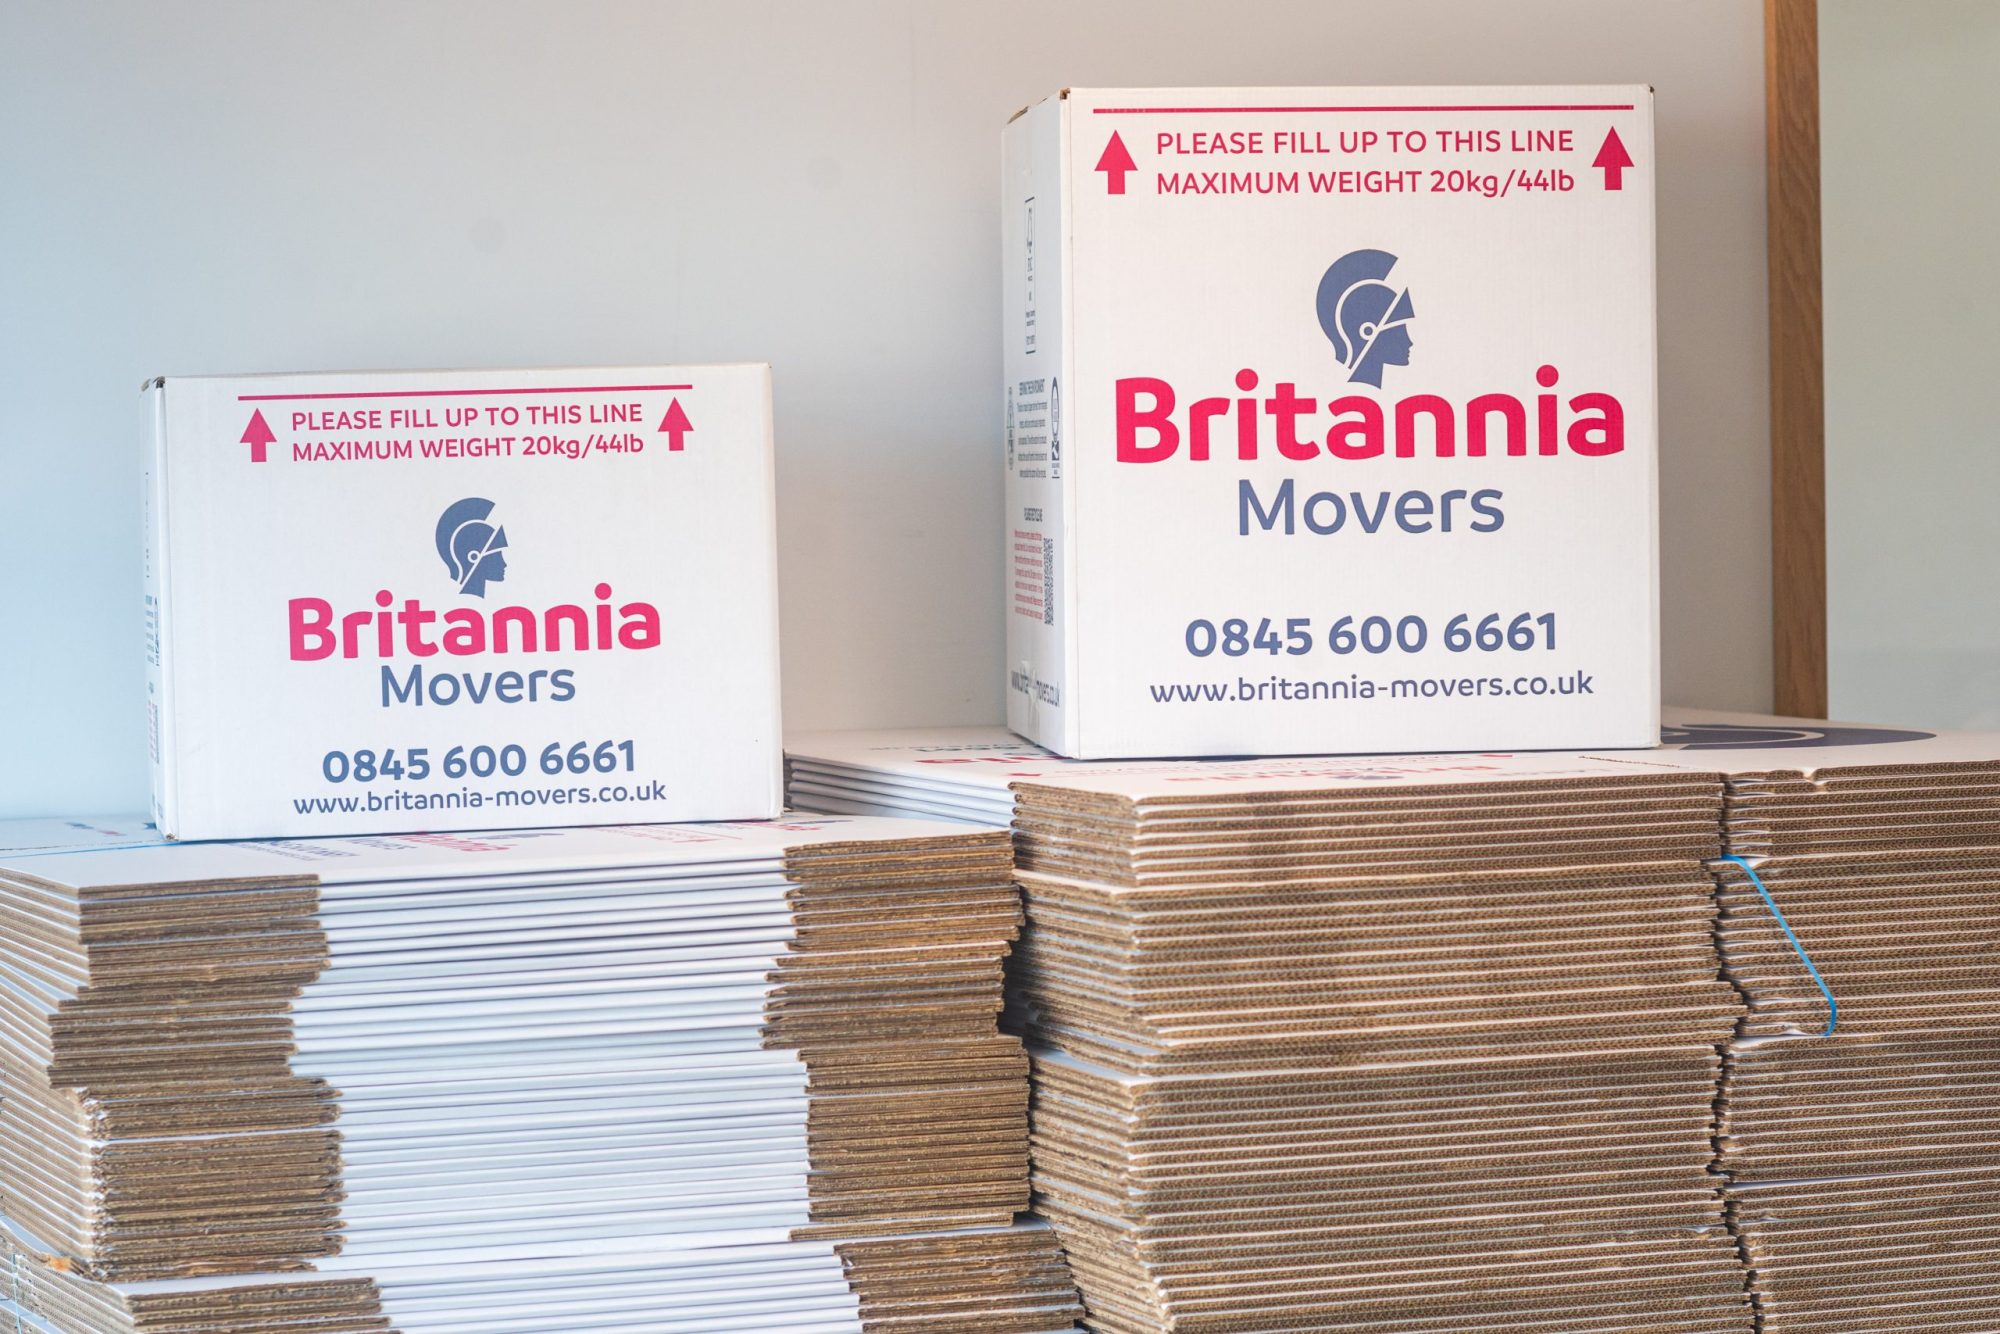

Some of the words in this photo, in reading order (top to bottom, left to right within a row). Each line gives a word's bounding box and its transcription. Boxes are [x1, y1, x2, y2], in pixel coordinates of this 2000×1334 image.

[1158, 132, 1263, 154] PLEASE
[1274, 132, 1330, 153] FILL
[1340, 131, 1378, 153] UP
[1387, 131, 1426, 153] TO
[1436, 130, 1501, 152] THIS
[1512, 130, 1573, 152] LINE
[1158, 172, 1298, 194] MAXIMUM
[1308, 171, 1422, 193] WEIGHT
[1430, 169, 1574, 198] 20kg/44lb
[292, 410, 382, 431] PLEASE
[390, 409, 438, 428] FILL
[446, 408, 478, 427] UP
[485, 406, 519, 426] TO
[526, 405, 582, 425] THIS
[590, 404, 642, 423] LINE
[1115, 364, 1624, 464] Britannia
[293, 440, 412, 462] MAXIMUM
[419, 437, 516, 458] WEIGHT
[522, 433, 643, 459] 20kg/44lb
[1239, 479, 1504, 536] Movers
[288, 583, 661, 661] Britannia
[1186, 618, 1312, 657] 0845
[1329, 615, 1427, 655] 600
[1444, 612, 1555, 652] 6661
[381, 664, 575, 707] Movers
[1150, 670, 1593, 702] www.britannia-movers.co.uk
[323, 748, 430, 783] 0845
[443, 744, 526, 779] 600
[540, 740, 634, 775] 6661
[293, 780, 666, 814] www.britannia-movers.co.uk
